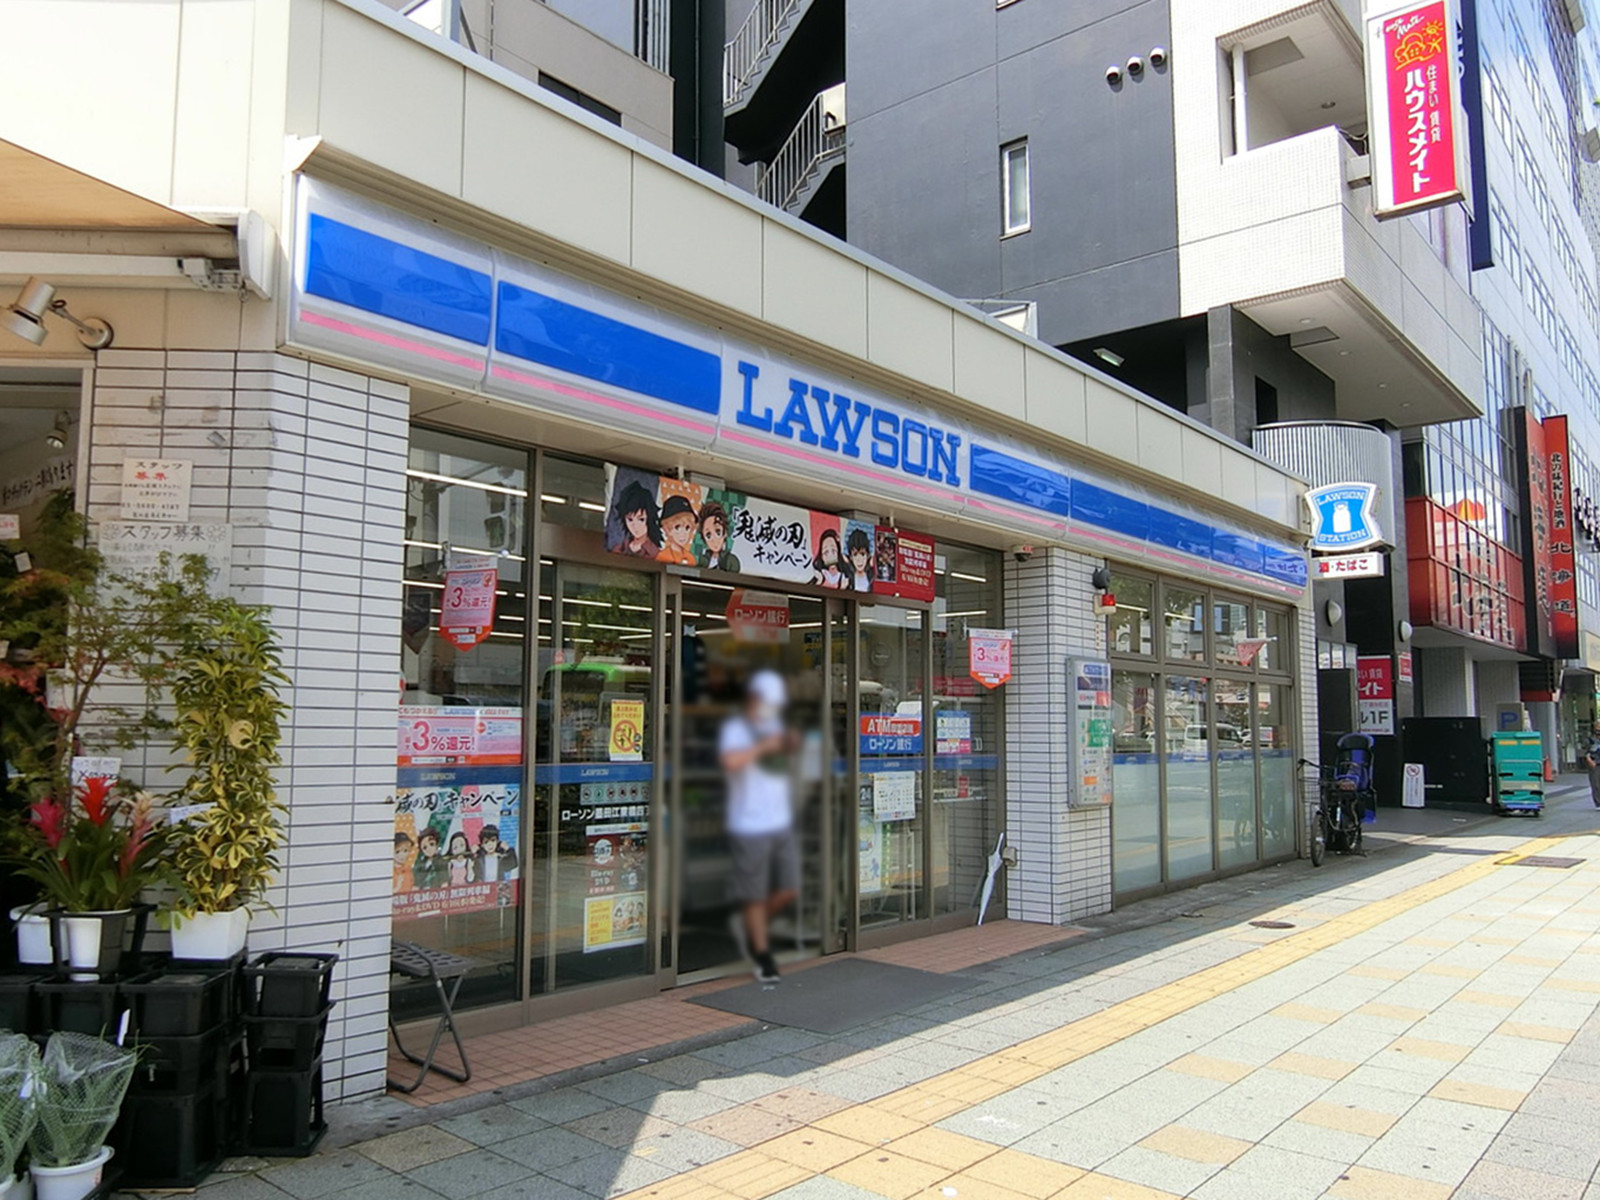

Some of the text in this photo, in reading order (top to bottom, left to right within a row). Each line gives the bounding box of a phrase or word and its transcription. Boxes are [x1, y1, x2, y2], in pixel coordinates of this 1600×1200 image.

[1427, 64, 1440, 107] 住まい
[1403, 68, 1430, 193] ハウスメイト
[736, 359, 961, 488] LAWSON
[1316, 491, 1366, 507] LAWSON
[1319, 529, 1368, 543] STATION
[753, 543, 814, 571] キャンペーン
[1549, 541, 1574, 613] 北海道
[867, 718, 892, 734] ATM
[1502, 712, 1519, 730] P
[444, 788, 519, 808] キャンペーン
